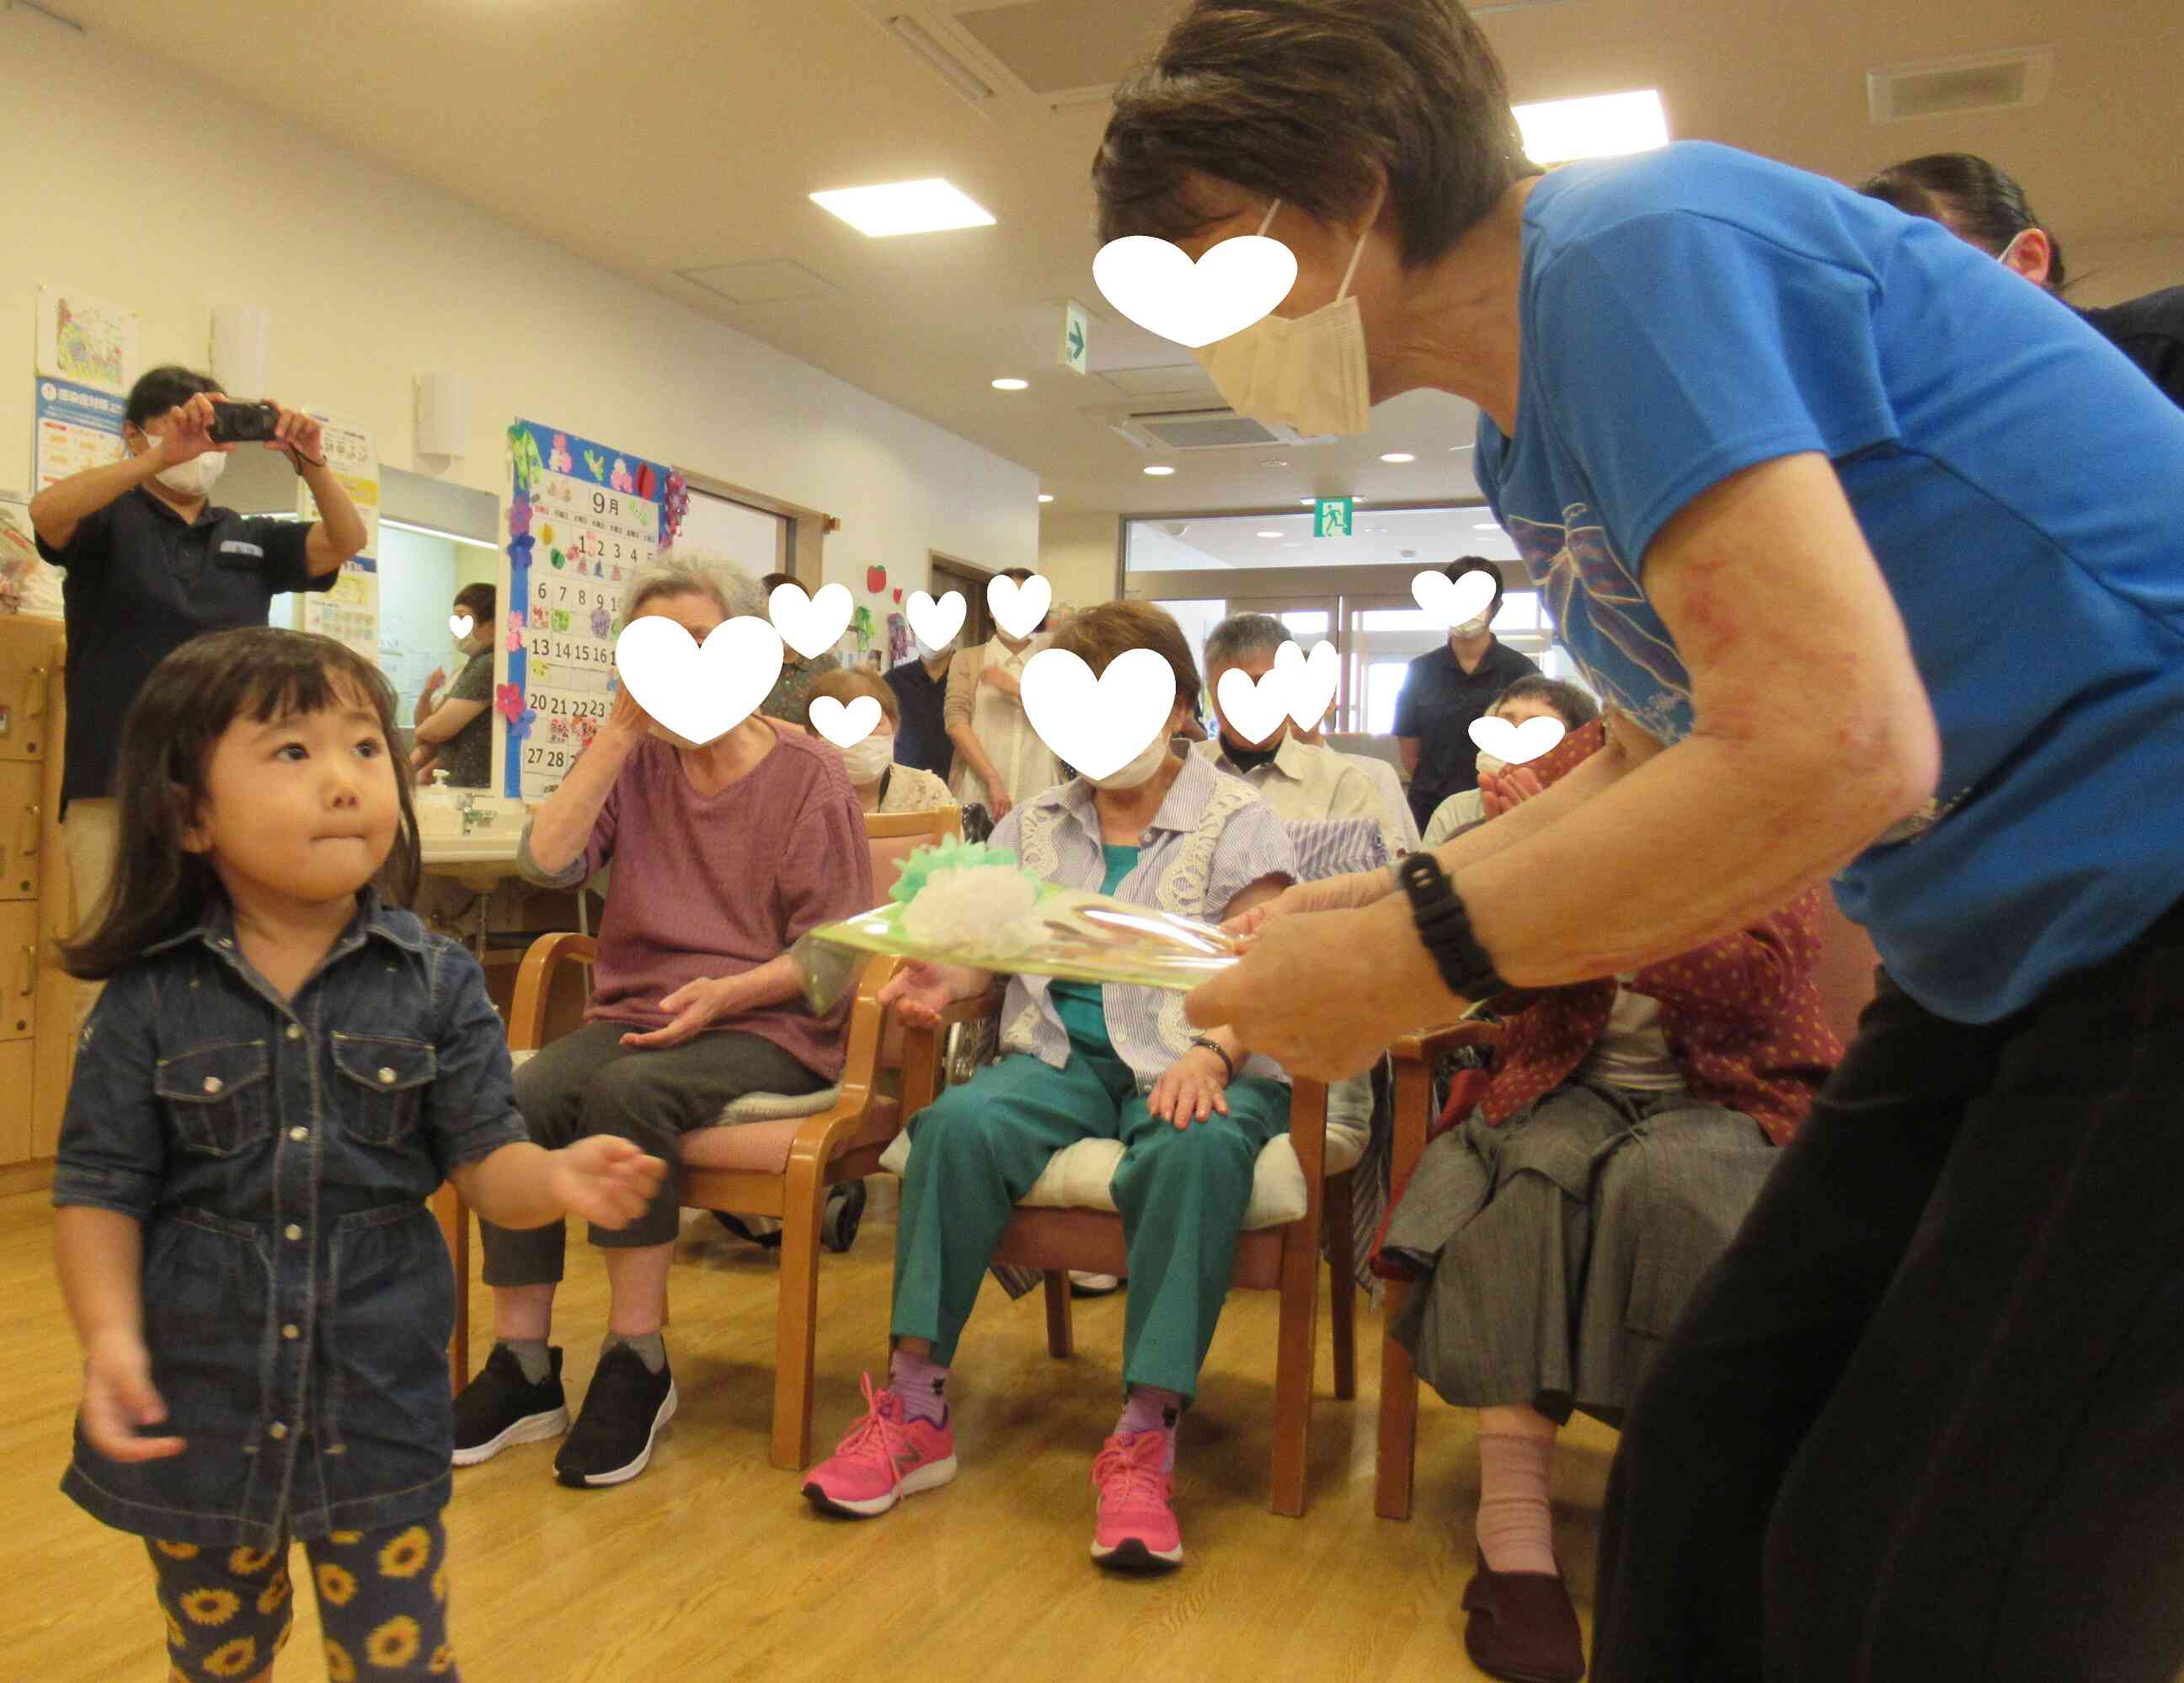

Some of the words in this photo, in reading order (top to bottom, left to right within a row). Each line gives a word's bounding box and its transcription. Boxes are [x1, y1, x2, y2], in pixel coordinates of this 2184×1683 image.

[593, 491, 619, 516] 9月
[579, 535, 585, 553] 1
[597, 540, 605, 557] 2
[613, 544, 621, 558] 3
[630, 548, 638, 563] 4
[538, 582, 547, 599] 6
[559, 586, 567, 601] 7
[579, 590, 586, 605] 8
[596, 594, 604, 608] 9
[531, 638, 550, 655] 13
[555, 642, 571, 659] 14
[575, 644, 590, 660] 15
[593, 647, 607, 663] 16
[530, 693, 547, 710] 20
[551, 697, 567, 715] 21
[572, 701, 588, 718] 22
[590, 700, 605, 718] 23
[527, 748, 543, 764] 27
[547, 751, 564, 767] 28
